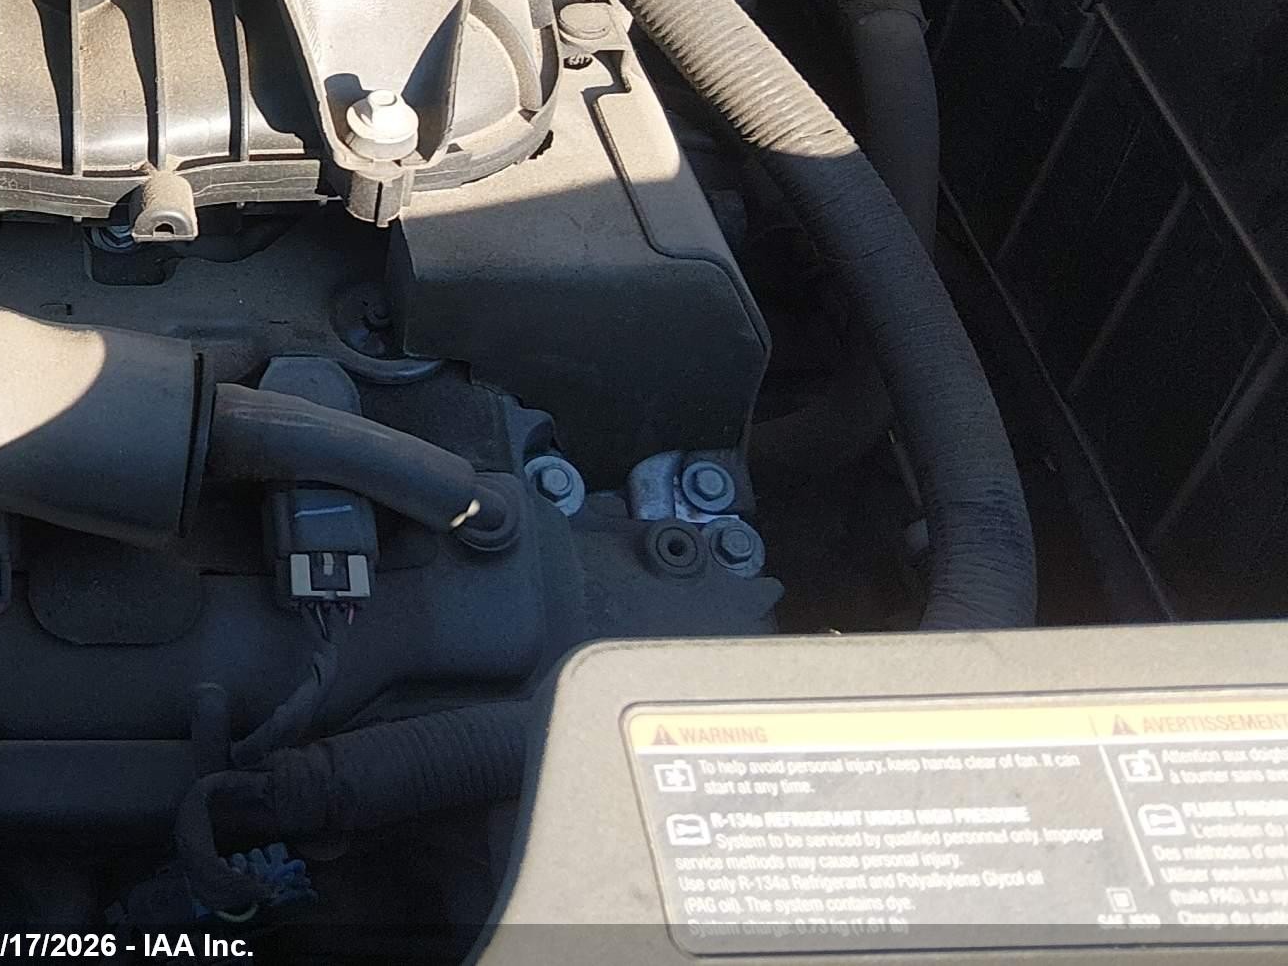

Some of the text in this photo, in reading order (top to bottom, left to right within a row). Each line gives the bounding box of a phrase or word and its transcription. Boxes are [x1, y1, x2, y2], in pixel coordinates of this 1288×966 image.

[678, 726, 768, 745] WARNING
[698, 760, 715, 774] To
[716, 759, 747, 776] help
[749, 759, 785, 775] avoid
[787, 758, 843, 775] personal
[886, 757, 921, 773] keep
[921, 756, 963, 771] hands
[964, 755, 997, 770] clear
[998, 753, 1013, 769] of
[1014, 753, 1040, 768] fan.
[1054, 753, 1080, 768] can
[703, 779, 816, 796] start at any time.
[709, 812, 763, 828] R-134a
[715, 833, 767, 851] System
[768, 833, 784, 849] to
[784, 832, 804, 848] be
[806, 831, 862, 848] serviced
[863, 832, 881, 849] by
[883, 830, 942, 849] qualified
[1010, 828, 1042, 846] only.
[1042, 826, 1104, 844] Improper
[675, 852, 963, 872] service methods may cause personal injury.
[678, 868, 1045, 894] Use only R-134a Refrigerant and Polyalkylene Glycol oil
[684, 895, 916, 916] (PAG oil). The system contains dye.
[687, 918, 741, 938] System
[794, 917, 829, 936] 0.73
[829, 918, 850, 937] kg
